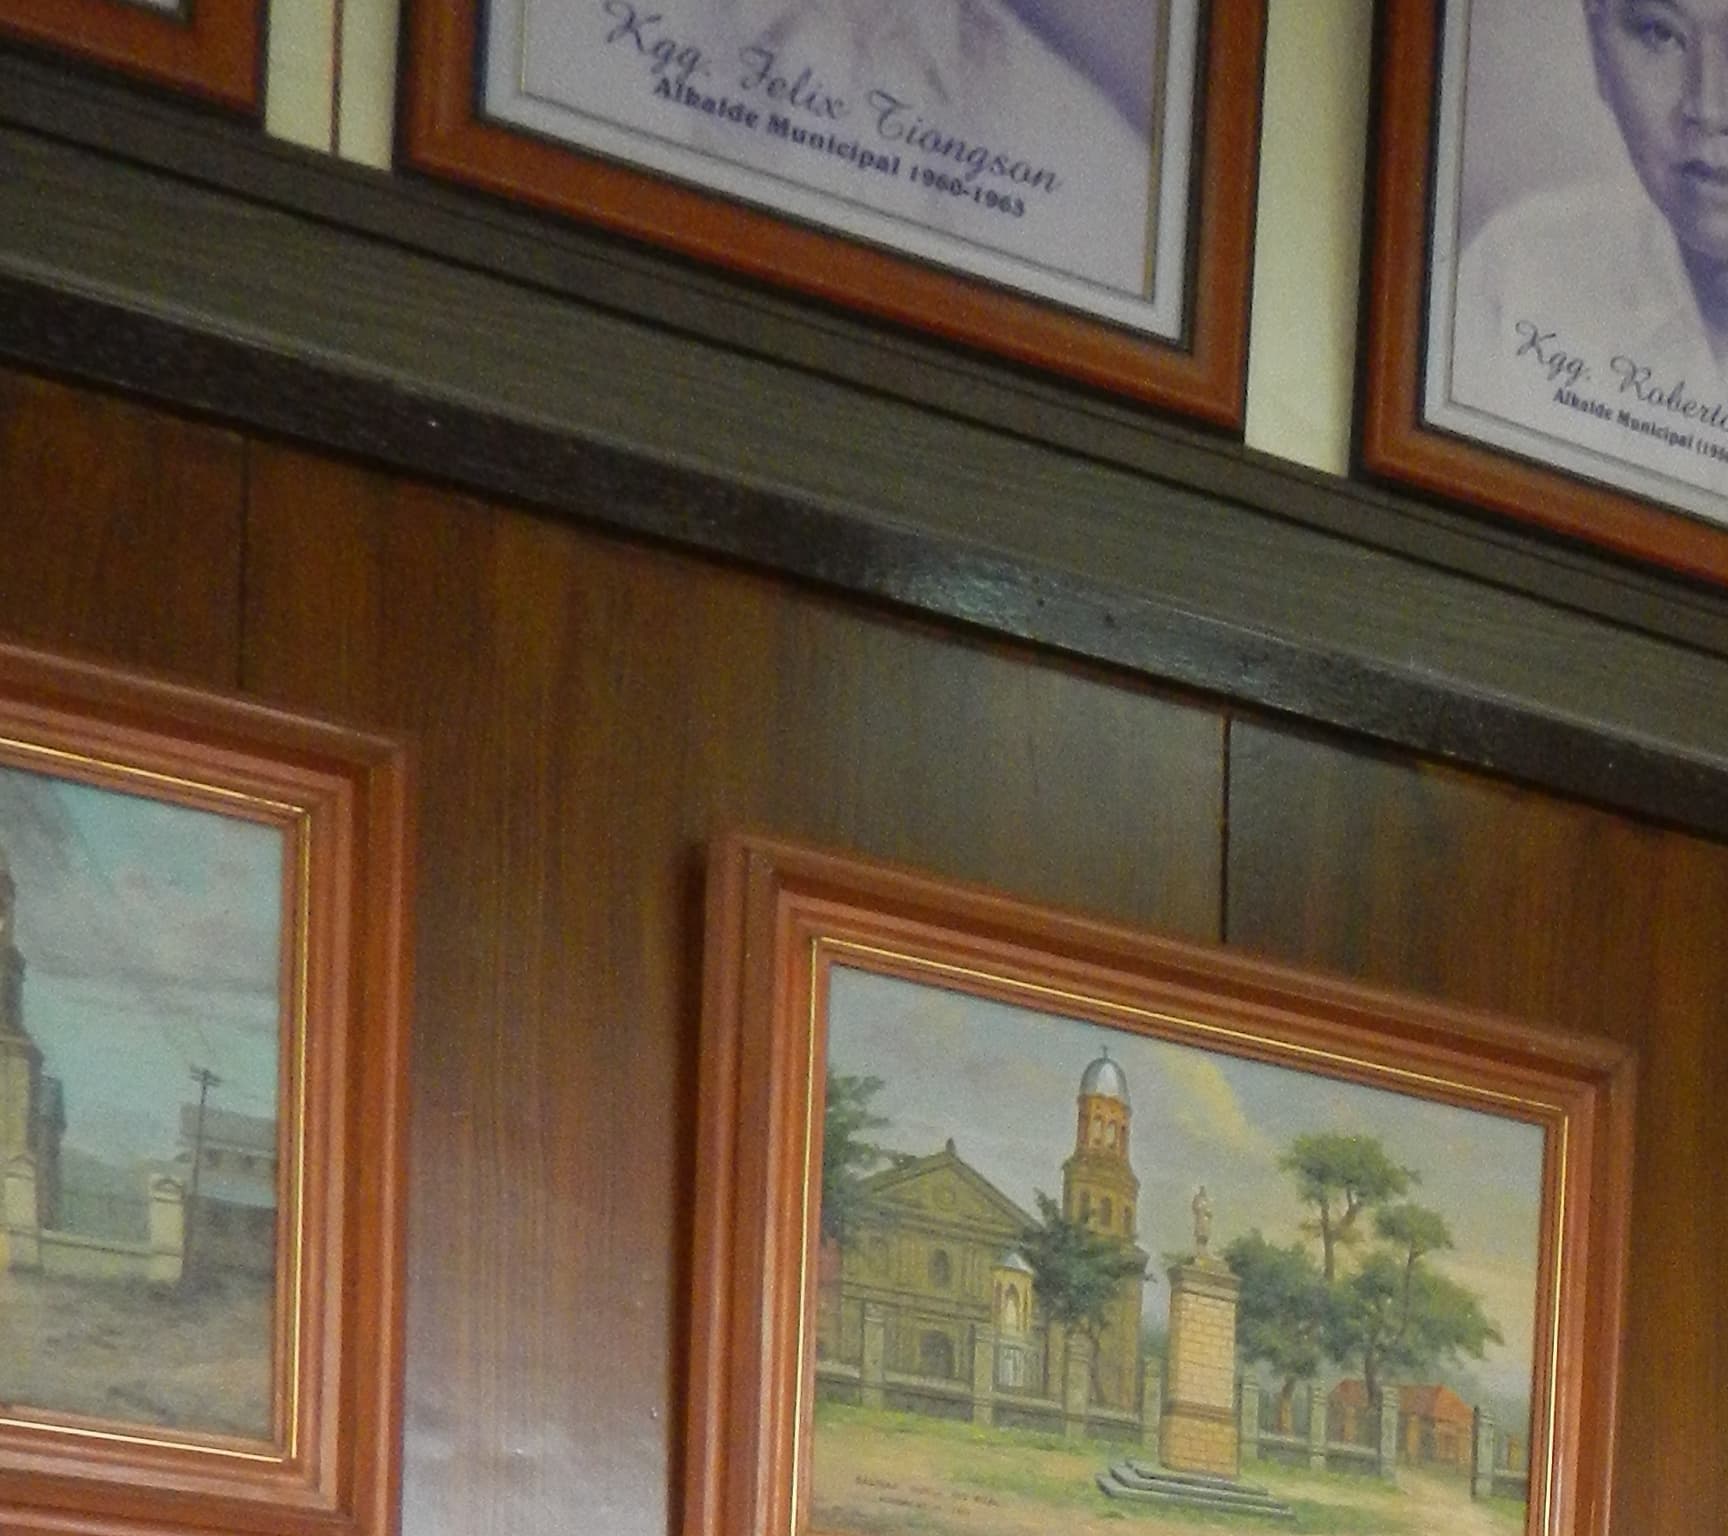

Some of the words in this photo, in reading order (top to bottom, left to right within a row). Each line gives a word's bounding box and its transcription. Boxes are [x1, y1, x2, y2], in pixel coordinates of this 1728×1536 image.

[606, 3, 710, 77] Kgg.
[739, 46, 845, 120] Felix
[869, 90, 1060, 193] Tiongson
[767, 114, 901, 176] Municipal
[1515, 319, 1590, 382] Kgg.
[1617, 410, 1694, 449] Municipal
